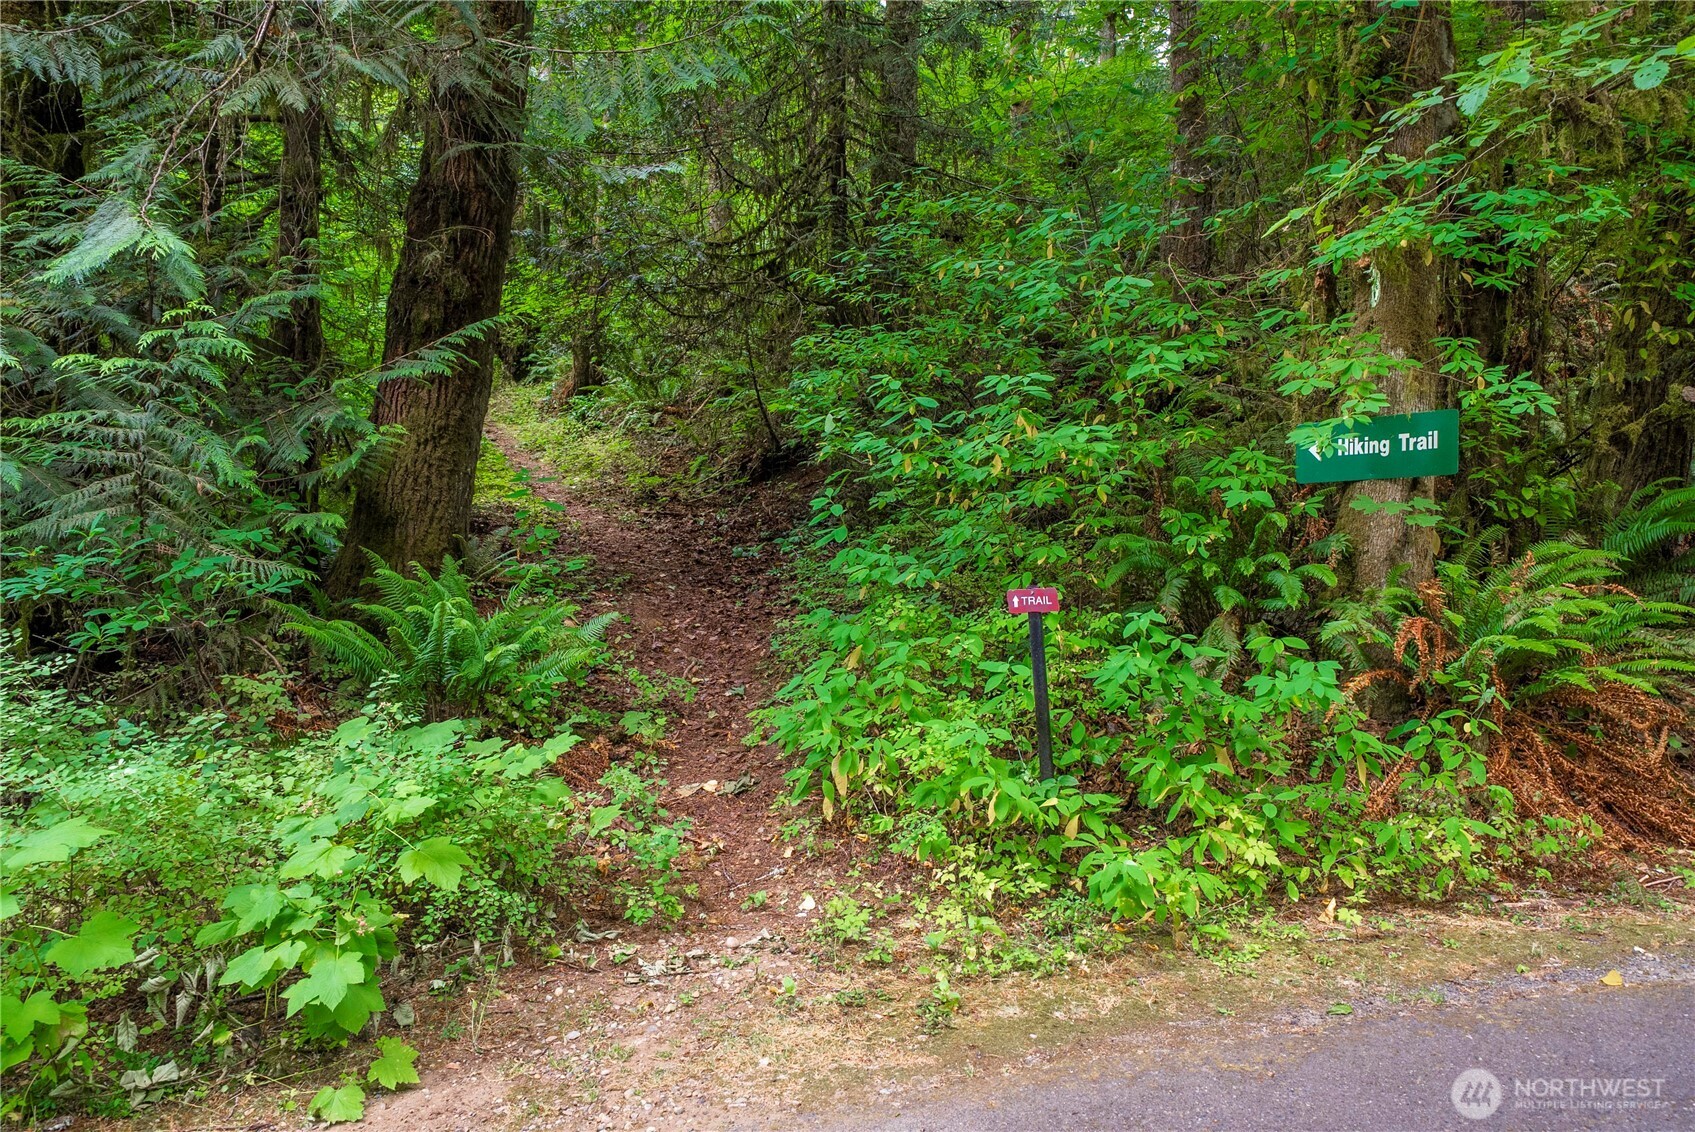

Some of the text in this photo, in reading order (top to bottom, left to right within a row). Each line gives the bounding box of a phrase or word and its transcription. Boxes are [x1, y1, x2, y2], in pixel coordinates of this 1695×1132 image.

[1337, 430, 1439, 457] Hiking Trail
[1020, 596, 1053, 606] TRAIL
